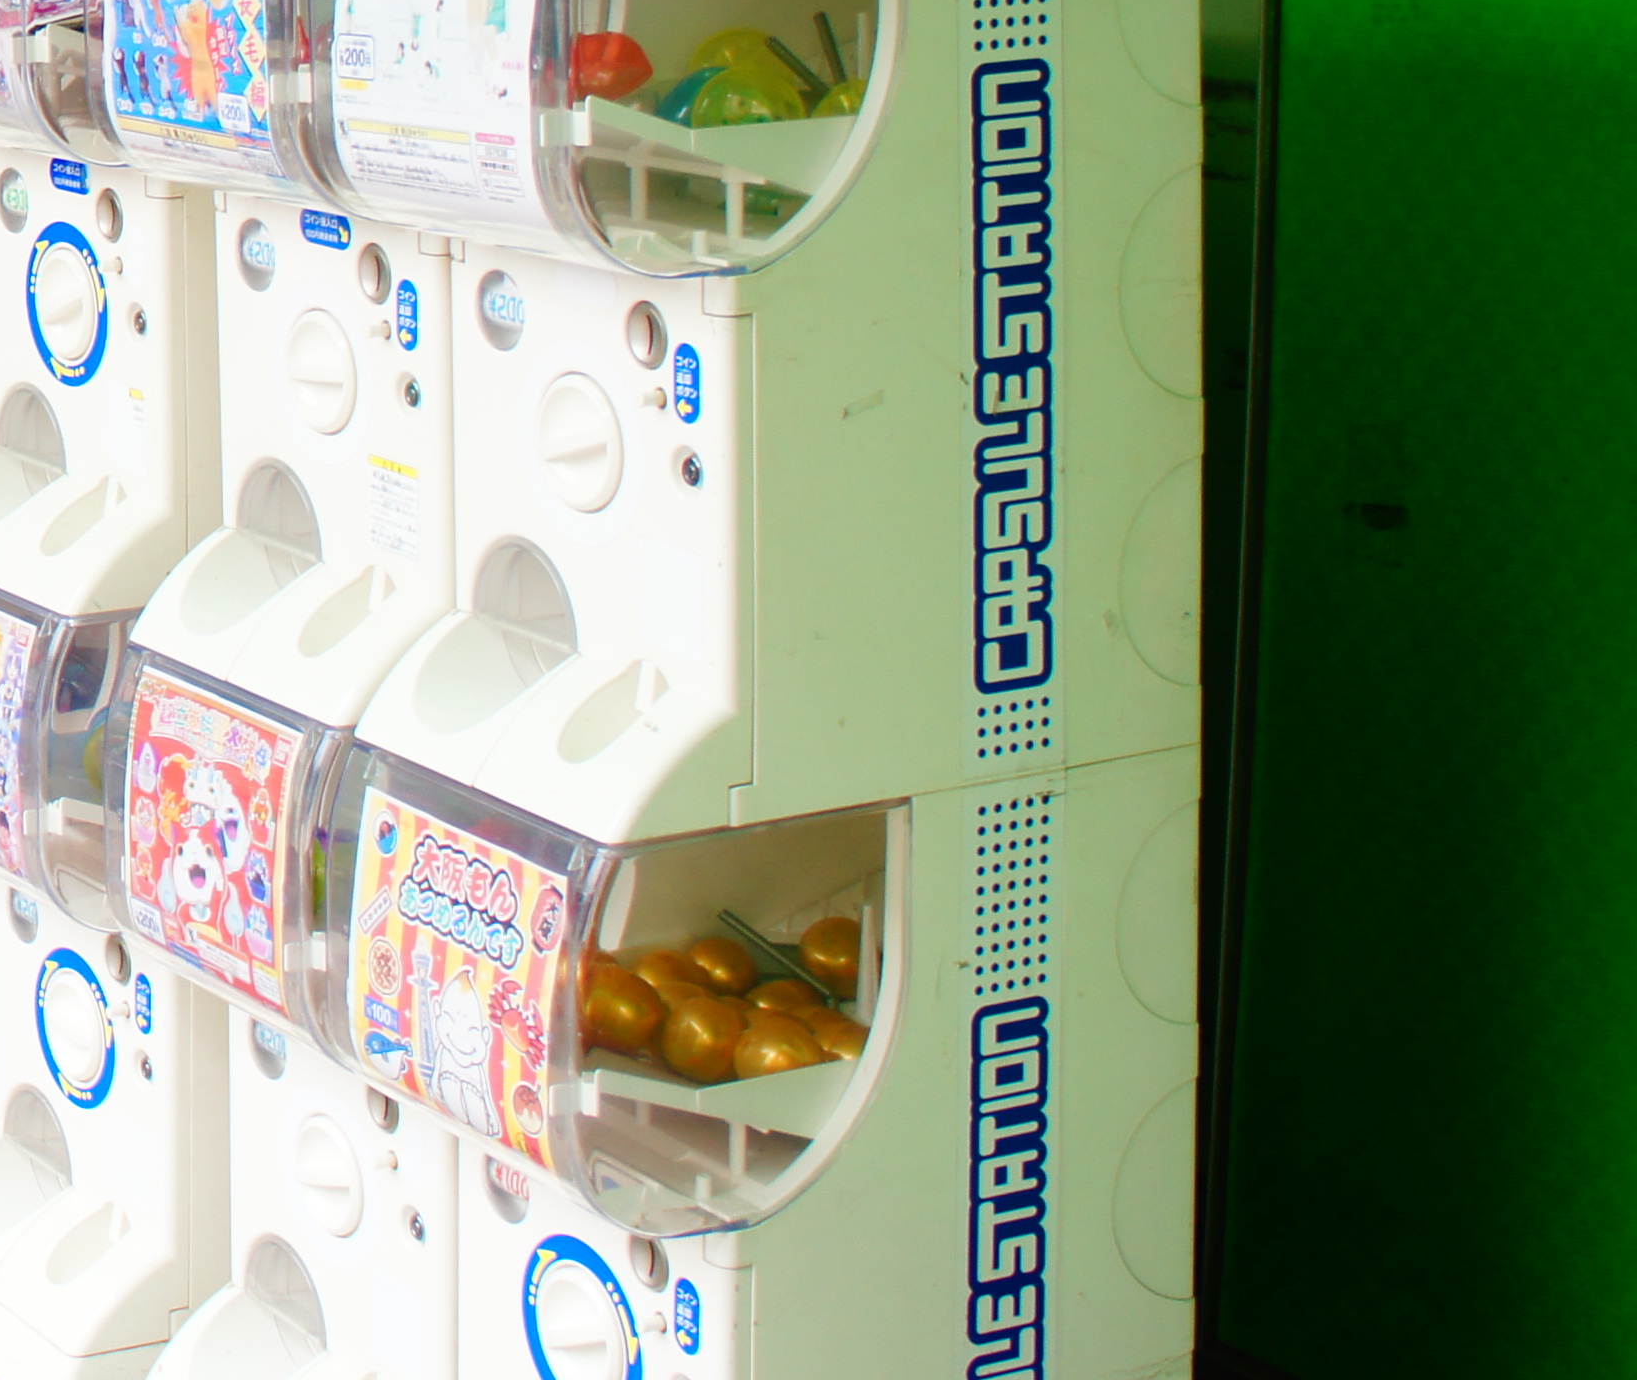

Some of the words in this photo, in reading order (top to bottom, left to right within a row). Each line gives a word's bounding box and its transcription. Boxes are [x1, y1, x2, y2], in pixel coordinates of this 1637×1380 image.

[977, 63, 1049, 363] STATION
[675, 355, 697, 370] コイン
[977, 364, 1049, 691] CAPSULE
[414, 839, 518, 924] 大阪もん
[974, 1002, 1046, 1287] STATION
